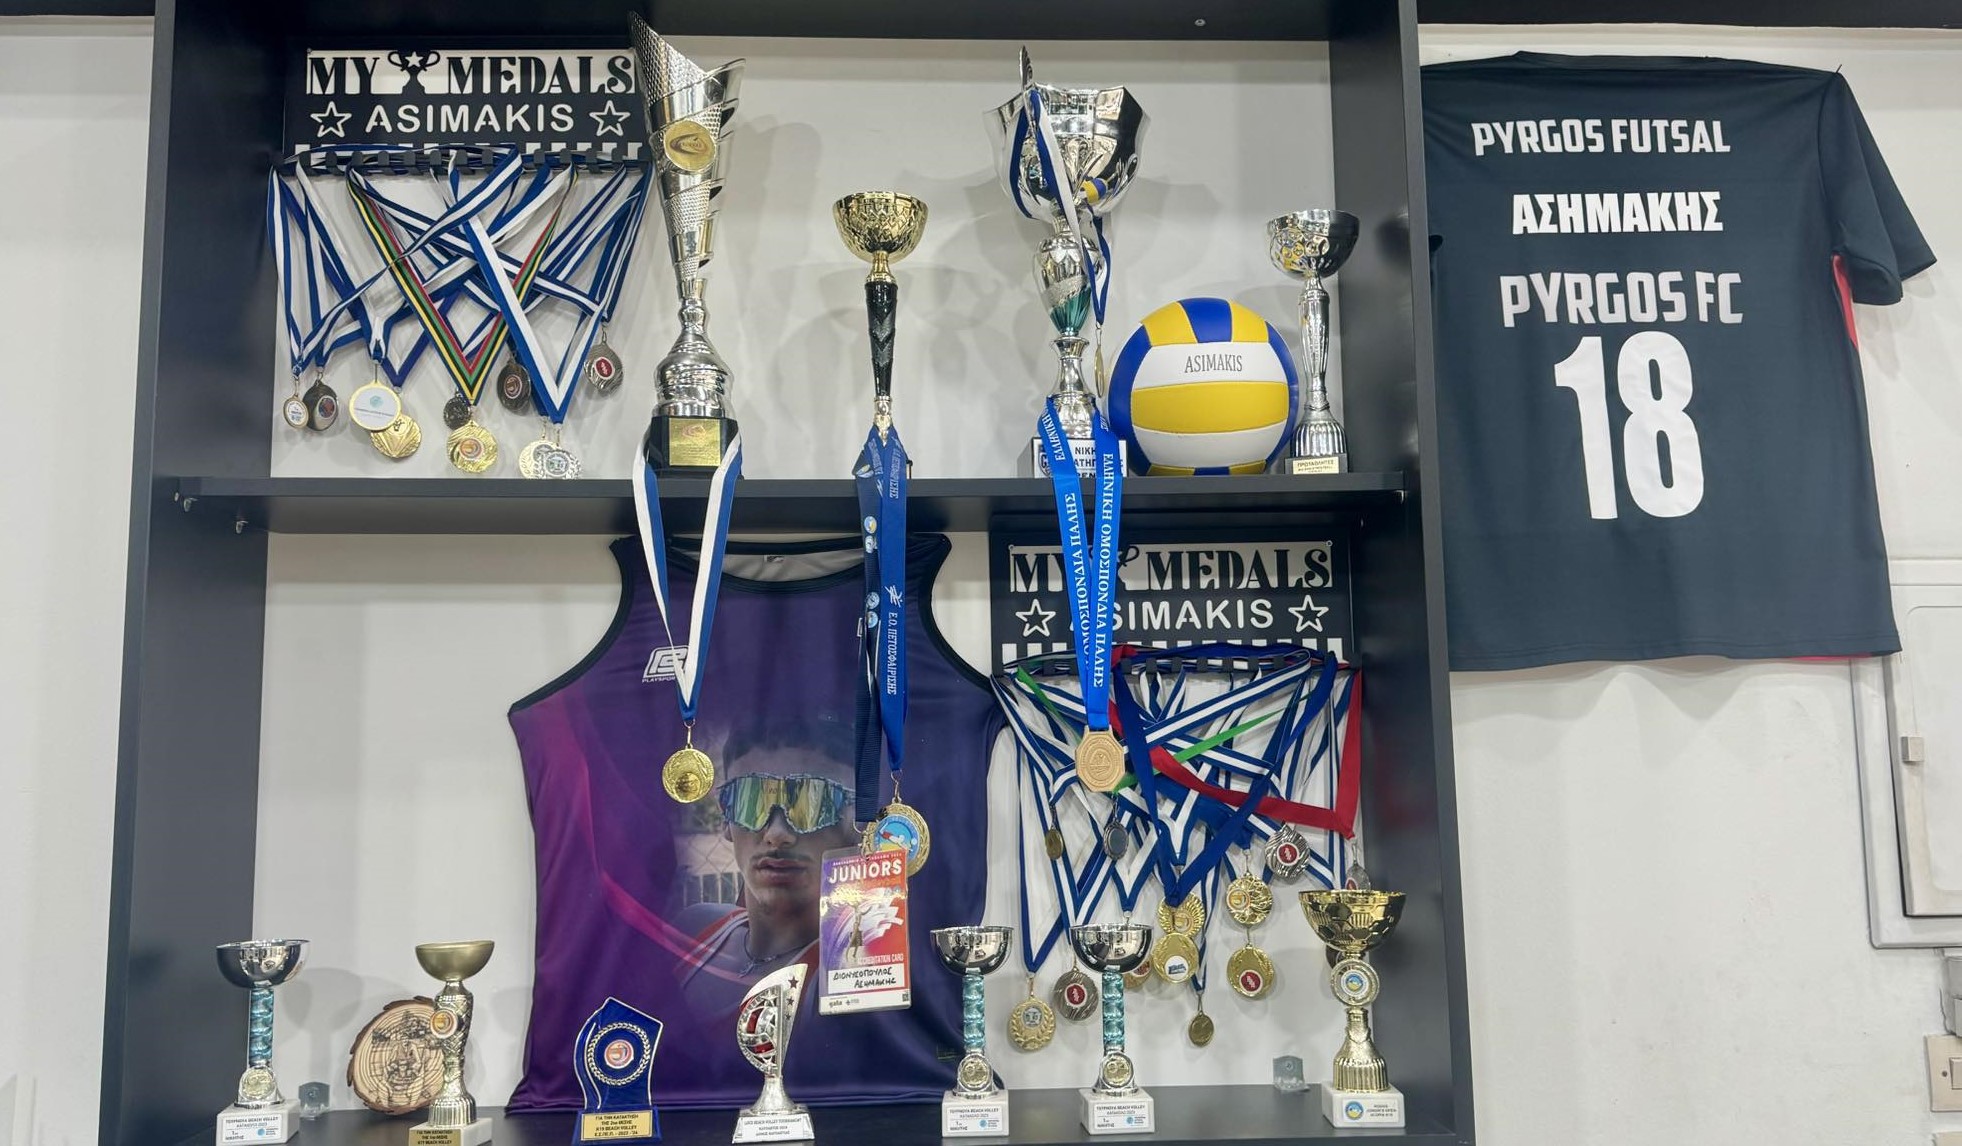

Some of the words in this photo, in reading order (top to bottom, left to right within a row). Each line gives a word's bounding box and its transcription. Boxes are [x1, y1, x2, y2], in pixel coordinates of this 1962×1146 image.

[308, 57, 379, 94] MY
[446, 55, 634, 94] MEDALS
[365, 103, 575, 133] ASIMAKIS
[1471, 118, 1605, 156] PYRGOS
[1611, 118, 1731, 153] FUTSAL
[1512, 191, 1724, 235] ΑΣΗΜΑΚΗΣ
[1499, 271, 1687, 328] PYRGOS
[1695, 271, 1744, 324] FC
[1184, 354, 1243, 373] ASIMAKIS
[1554, 330, 1704, 520] 18
[1101, 453, 1114, 520] ΕΛΛΗΝΙΚΗ
[1064, 492, 1082, 547] ΠΑΛΗΣ
[1096, 525, 1112, 630] ΟΜΟΣΠΟΝΔΙΑ
[1146, 548, 1331, 591] MEDALS
[1070, 599, 1274, 631] SIMAKIS
[1093, 633, 1106, 688] ΠΑΛΗΣ
[829, 858, 902, 883] JUNIORS
